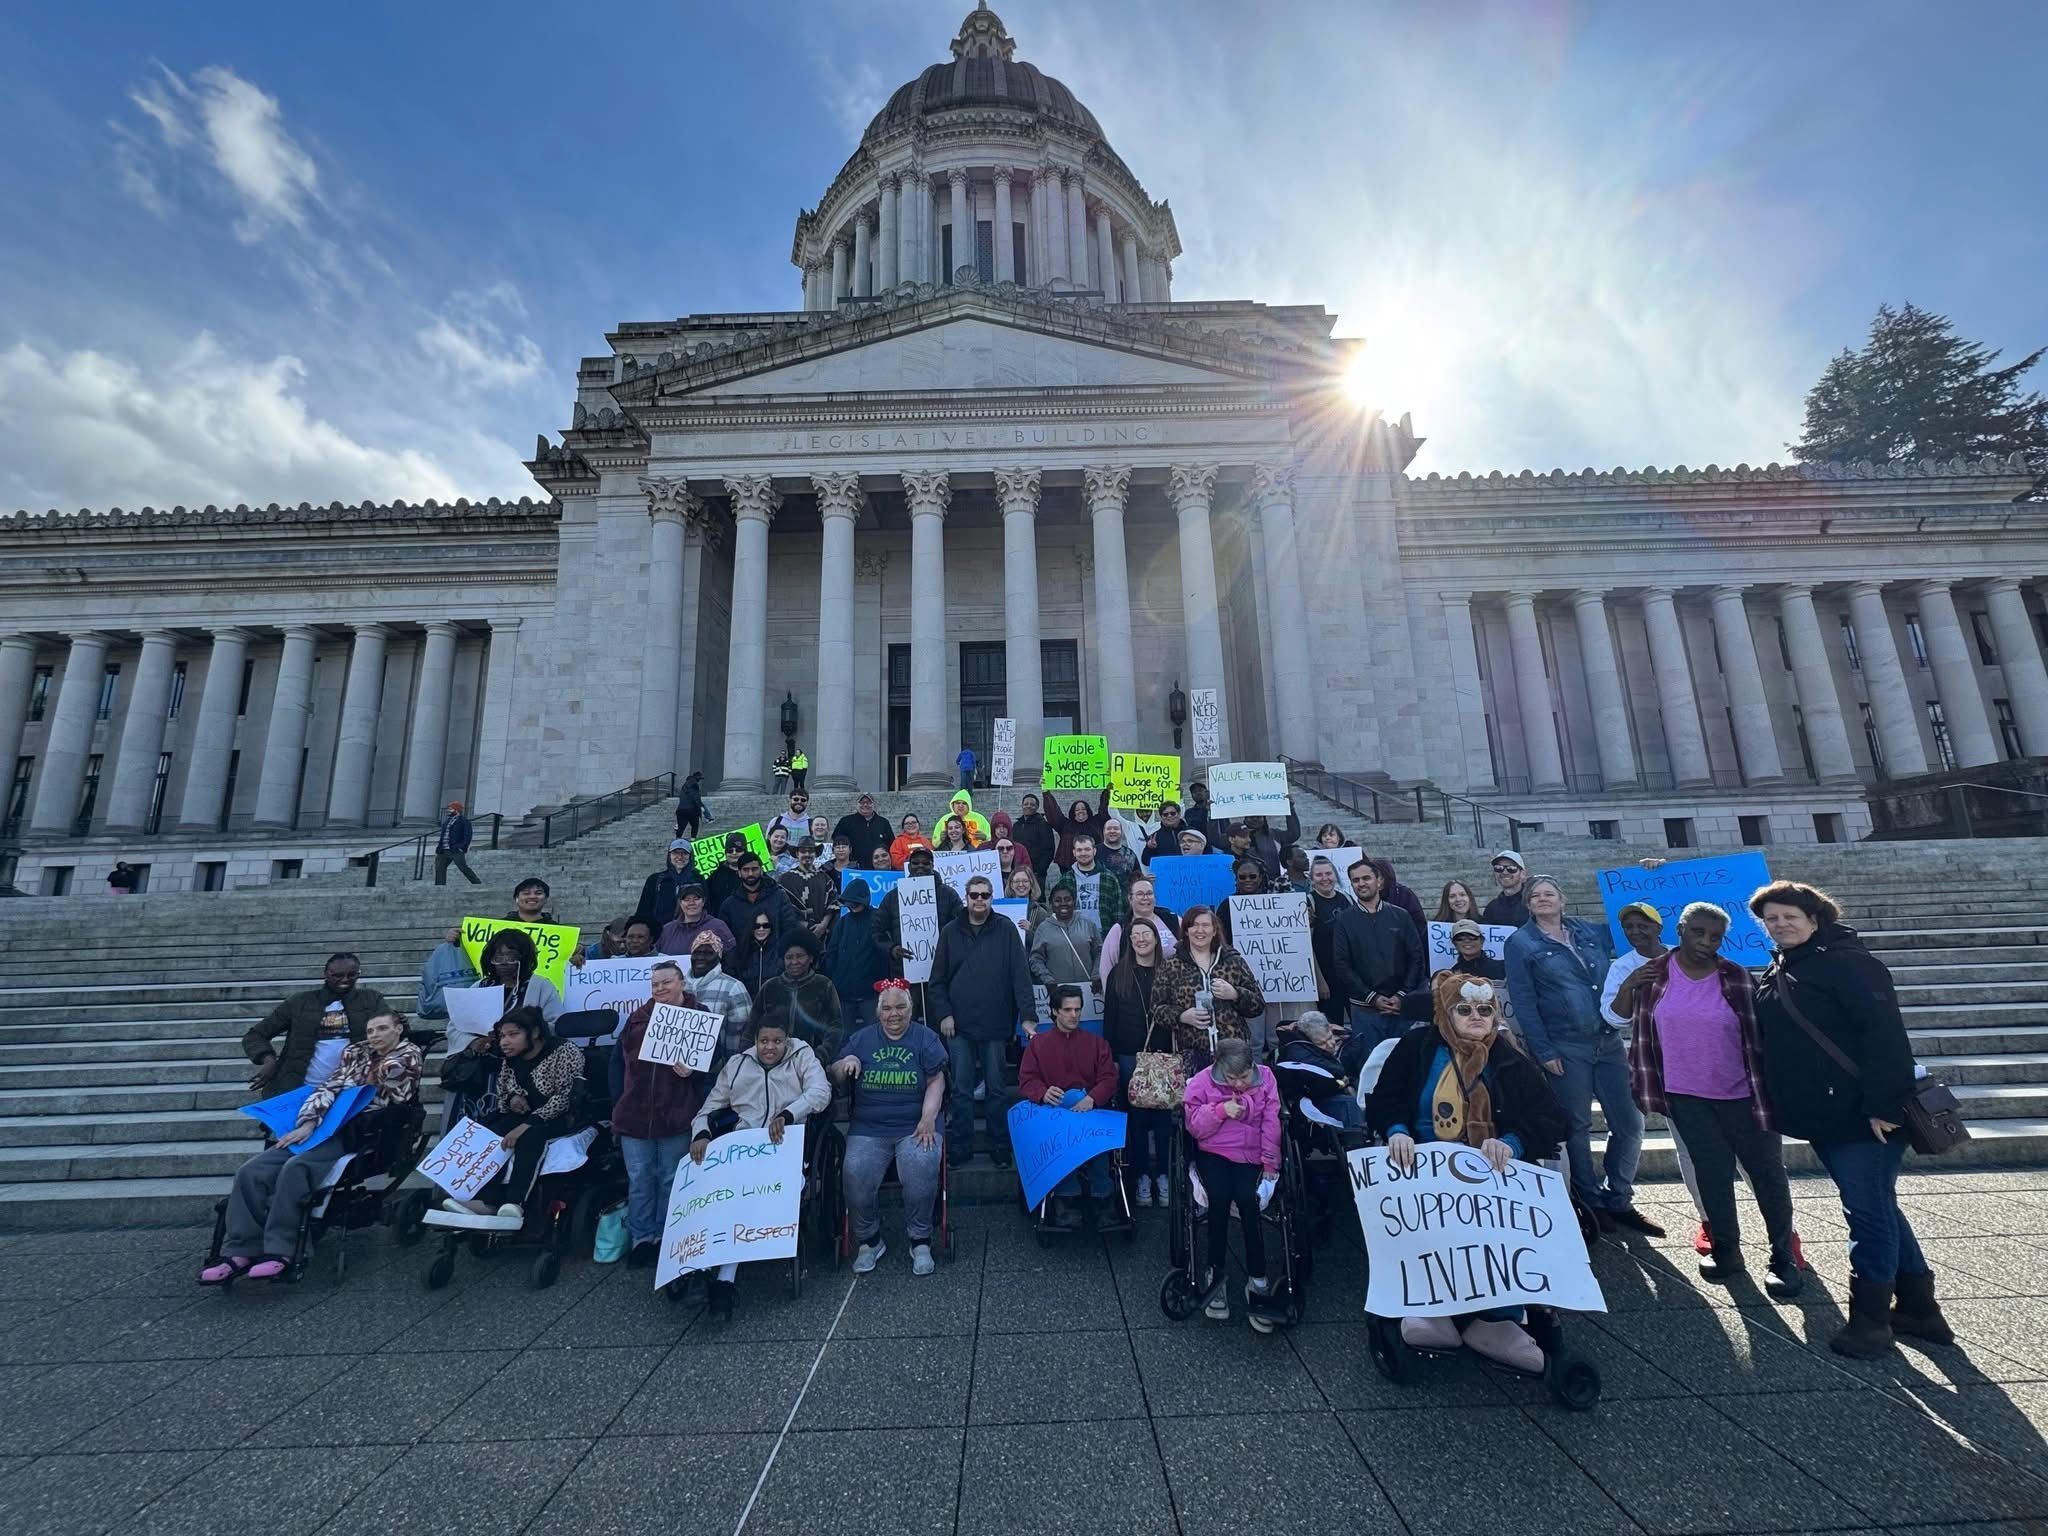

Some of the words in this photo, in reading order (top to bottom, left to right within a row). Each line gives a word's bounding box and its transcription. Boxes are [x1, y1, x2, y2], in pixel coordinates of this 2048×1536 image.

[792, 431, 976, 450] LEGISLATIVE
[1014, 427, 1150, 444] BUILDING
[1192, 691, 1215, 705] WE
[1193, 704, 1218, 717] NEED
[996, 720, 1012, 731] WE
[1049, 739, 1094, 755] Livable
[1115, 756, 1124, 772] A
[1134, 757, 1170, 779] Living
[1210, 768, 1244, 783] VALUE
[1247, 771, 1261, 780] THE
[1055, 773, 1108, 788] RESPECT
[1112, 788, 1165, 806] Supported
[1239, 793, 1254, 801] THE
[694, 836, 725, 857] IGHT
[938, 864, 966, 877] IVING
[1604, 869, 1734, 894] PRIORITIZE
[900, 888, 936, 906] WAGE
[1232, 897, 1285, 911] VALUE
[901, 914, 937, 938] PARITY
[1240, 914, 1263, 929] the
[1239, 936, 1299, 956] VALUE
[1259, 955, 1282, 971] the
[655, 1005, 719, 1034] SUPPORT
[648, 1023, 716, 1053] SUPPORTED
[651, 1042, 699, 1068] LIVING
[872, 1046, 914, 1064] SEATTLE
[863, 1070, 918, 1085] SEAHAWKS
[422, 1120, 481, 1175] Support
[679, 1161, 696, 1192] I
[703, 1142, 781, 1172] SUPPORT
[1348, 1155, 1380, 1191] WE
[1387, 1150, 1555, 1198] SUPPORT
[669, 1188, 735, 1228] SUPPORTED
[743, 1182, 782, 1197] LIVING
[1380, 1192, 1553, 1238] SUPPORTED
[670, 1228, 709, 1259] LIVABLE
[679, 1243, 706, 1265] WAGE
[1400, 1243, 1551, 1307] LIVING
